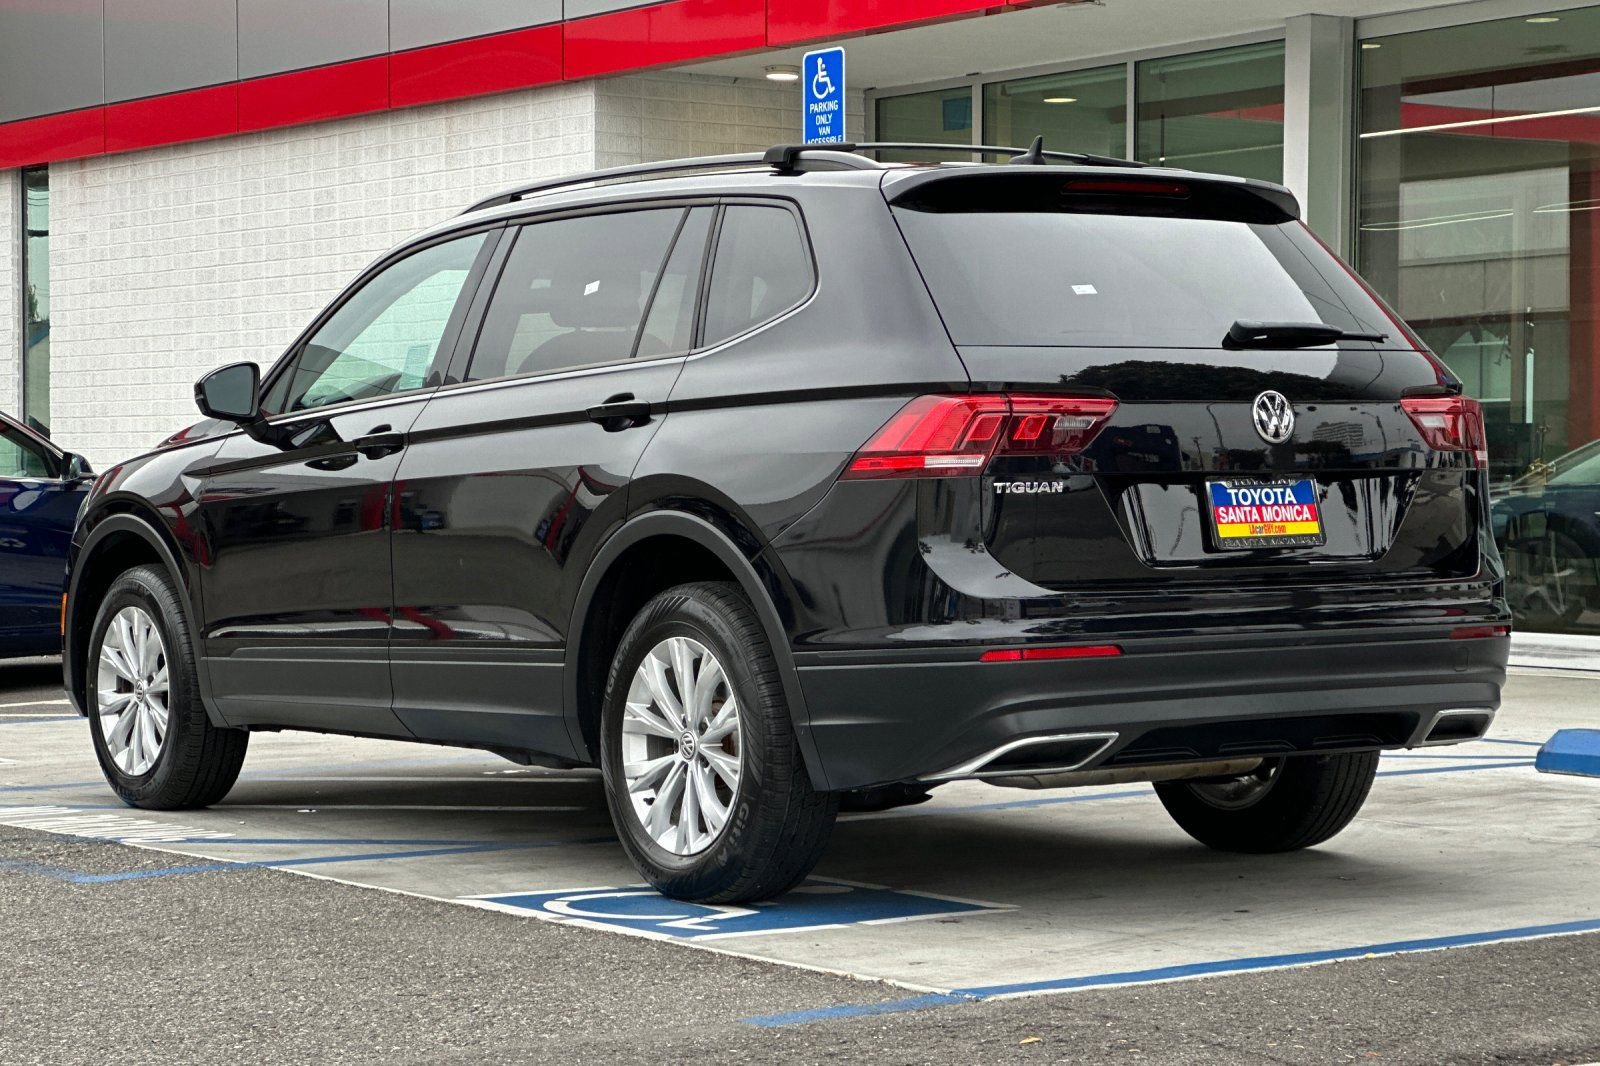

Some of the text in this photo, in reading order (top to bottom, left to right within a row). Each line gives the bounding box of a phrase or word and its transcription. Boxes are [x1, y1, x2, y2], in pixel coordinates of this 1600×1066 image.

[810, 100, 838, 114] PARKING
[816, 113, 832, 125] ONLY
[818, 126, 830, 136] VAN
[993, 481, 1064, 494] TIGUAN
[1226, 487, 1298, 506] TOYOTA
[1218, 504, 1312, 523] SANTA MONICA
